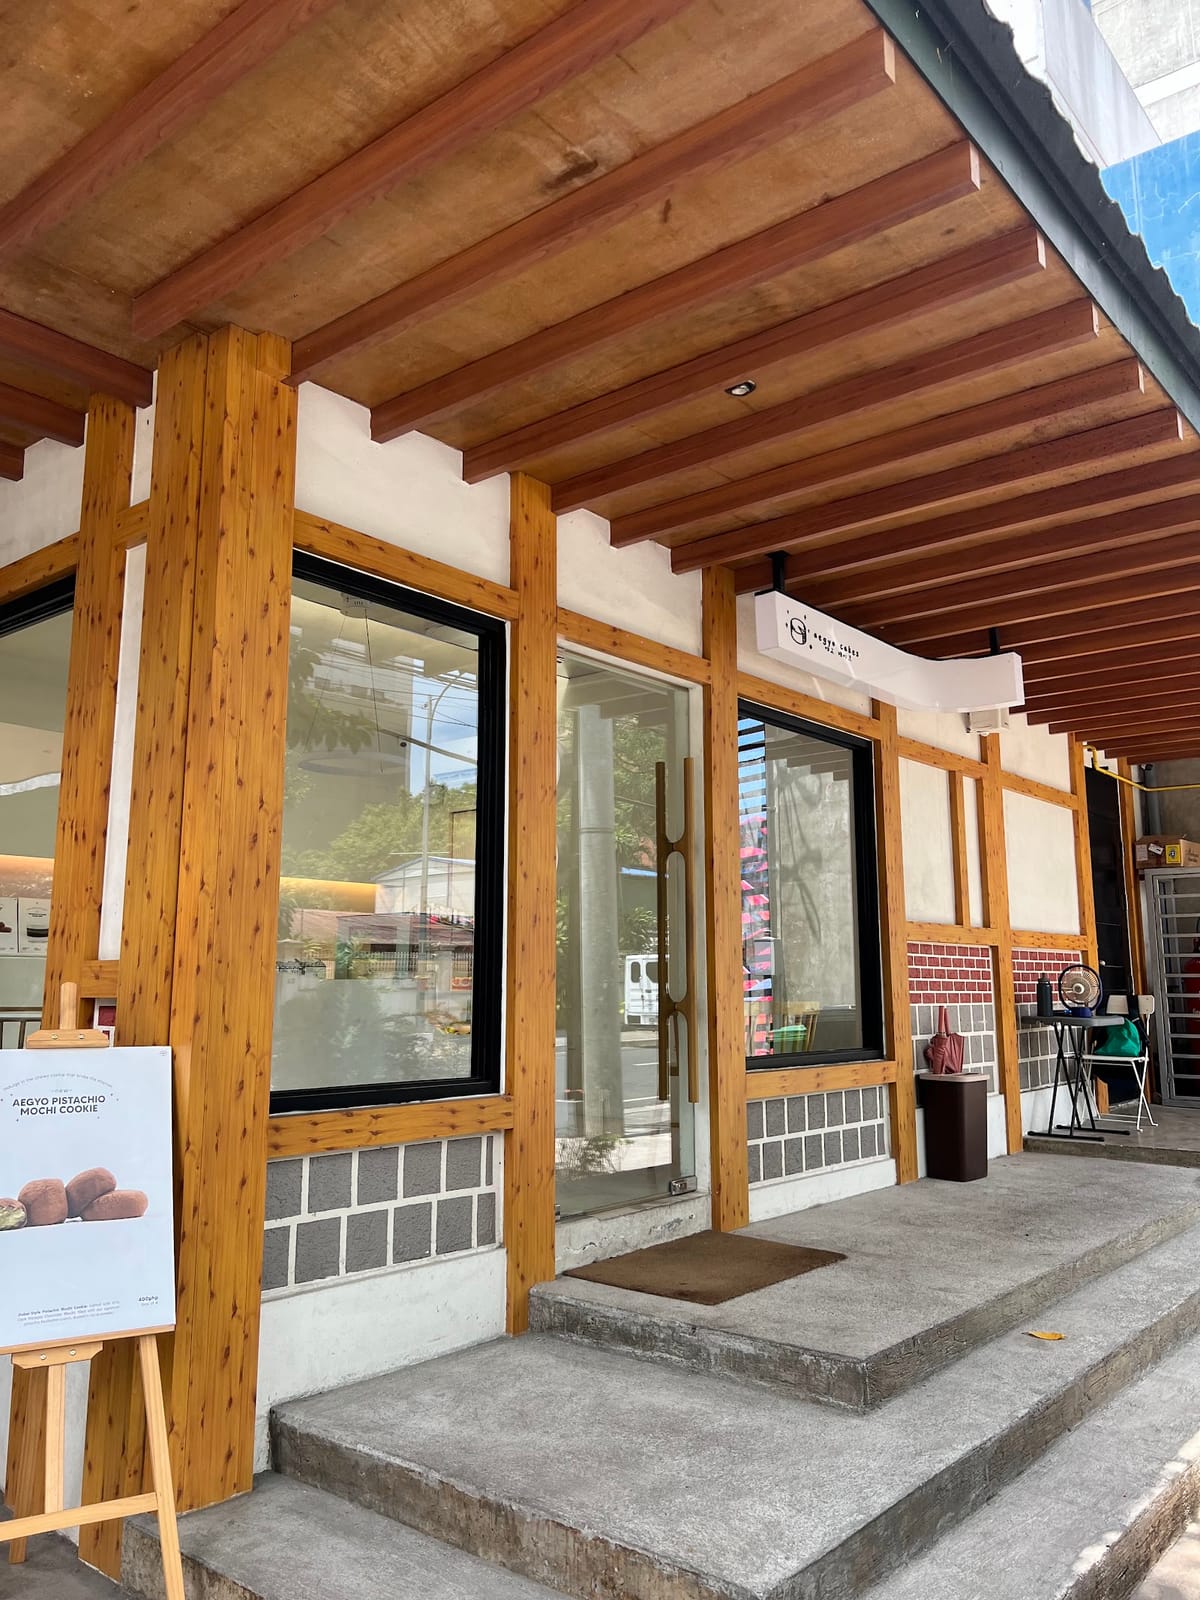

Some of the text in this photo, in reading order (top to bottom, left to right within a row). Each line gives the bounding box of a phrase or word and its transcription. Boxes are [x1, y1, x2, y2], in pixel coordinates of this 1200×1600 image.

[814, 633, 835, 647] aegyo
[840, 644, 859, 657] cakes
[12, 1095, 106, 1107] AEGYO PISTACHIO
[20, 1104, 98, 1116] MOCHI COOKIE
